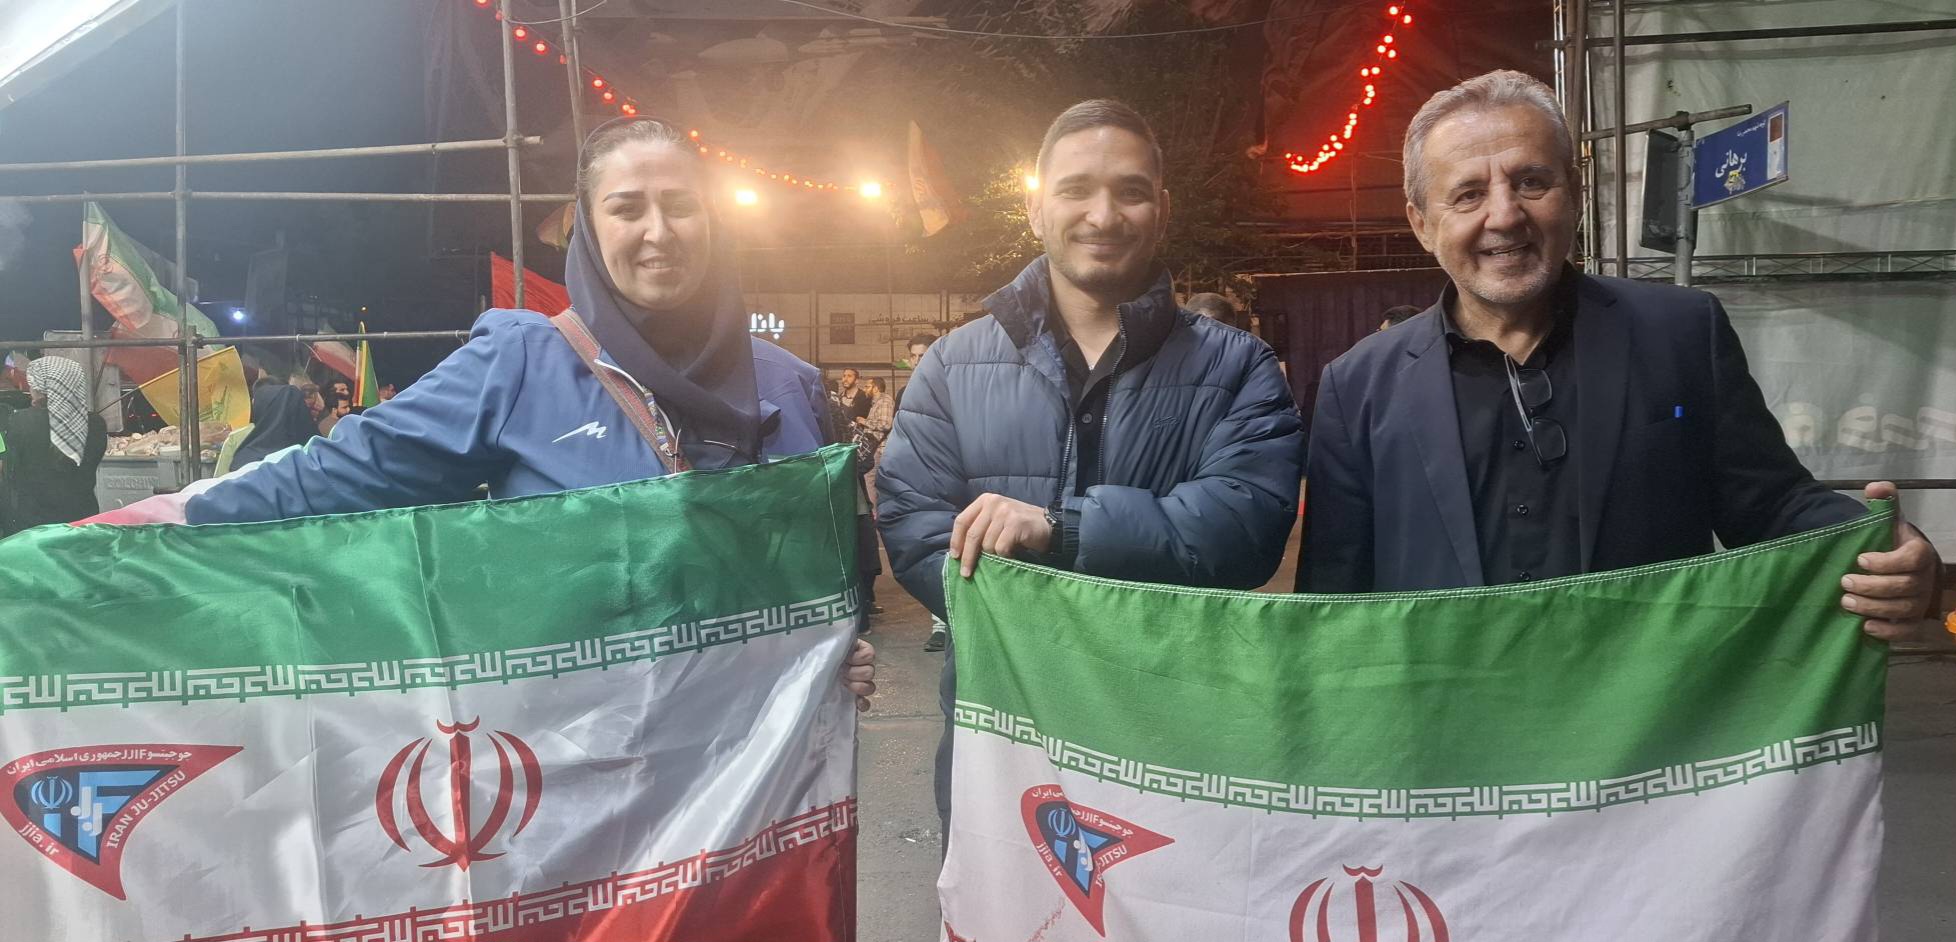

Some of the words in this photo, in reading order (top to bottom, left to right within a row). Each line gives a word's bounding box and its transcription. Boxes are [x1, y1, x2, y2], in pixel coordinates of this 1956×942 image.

[1714, 149, 1748, 178] برهانی
[7, 758, 35, 775] ایران
[36, 753, 78, 767] اسلامی
[105, 815, 132, 849] IRAN
[131, 770, 187, 817] JU-JITSU
